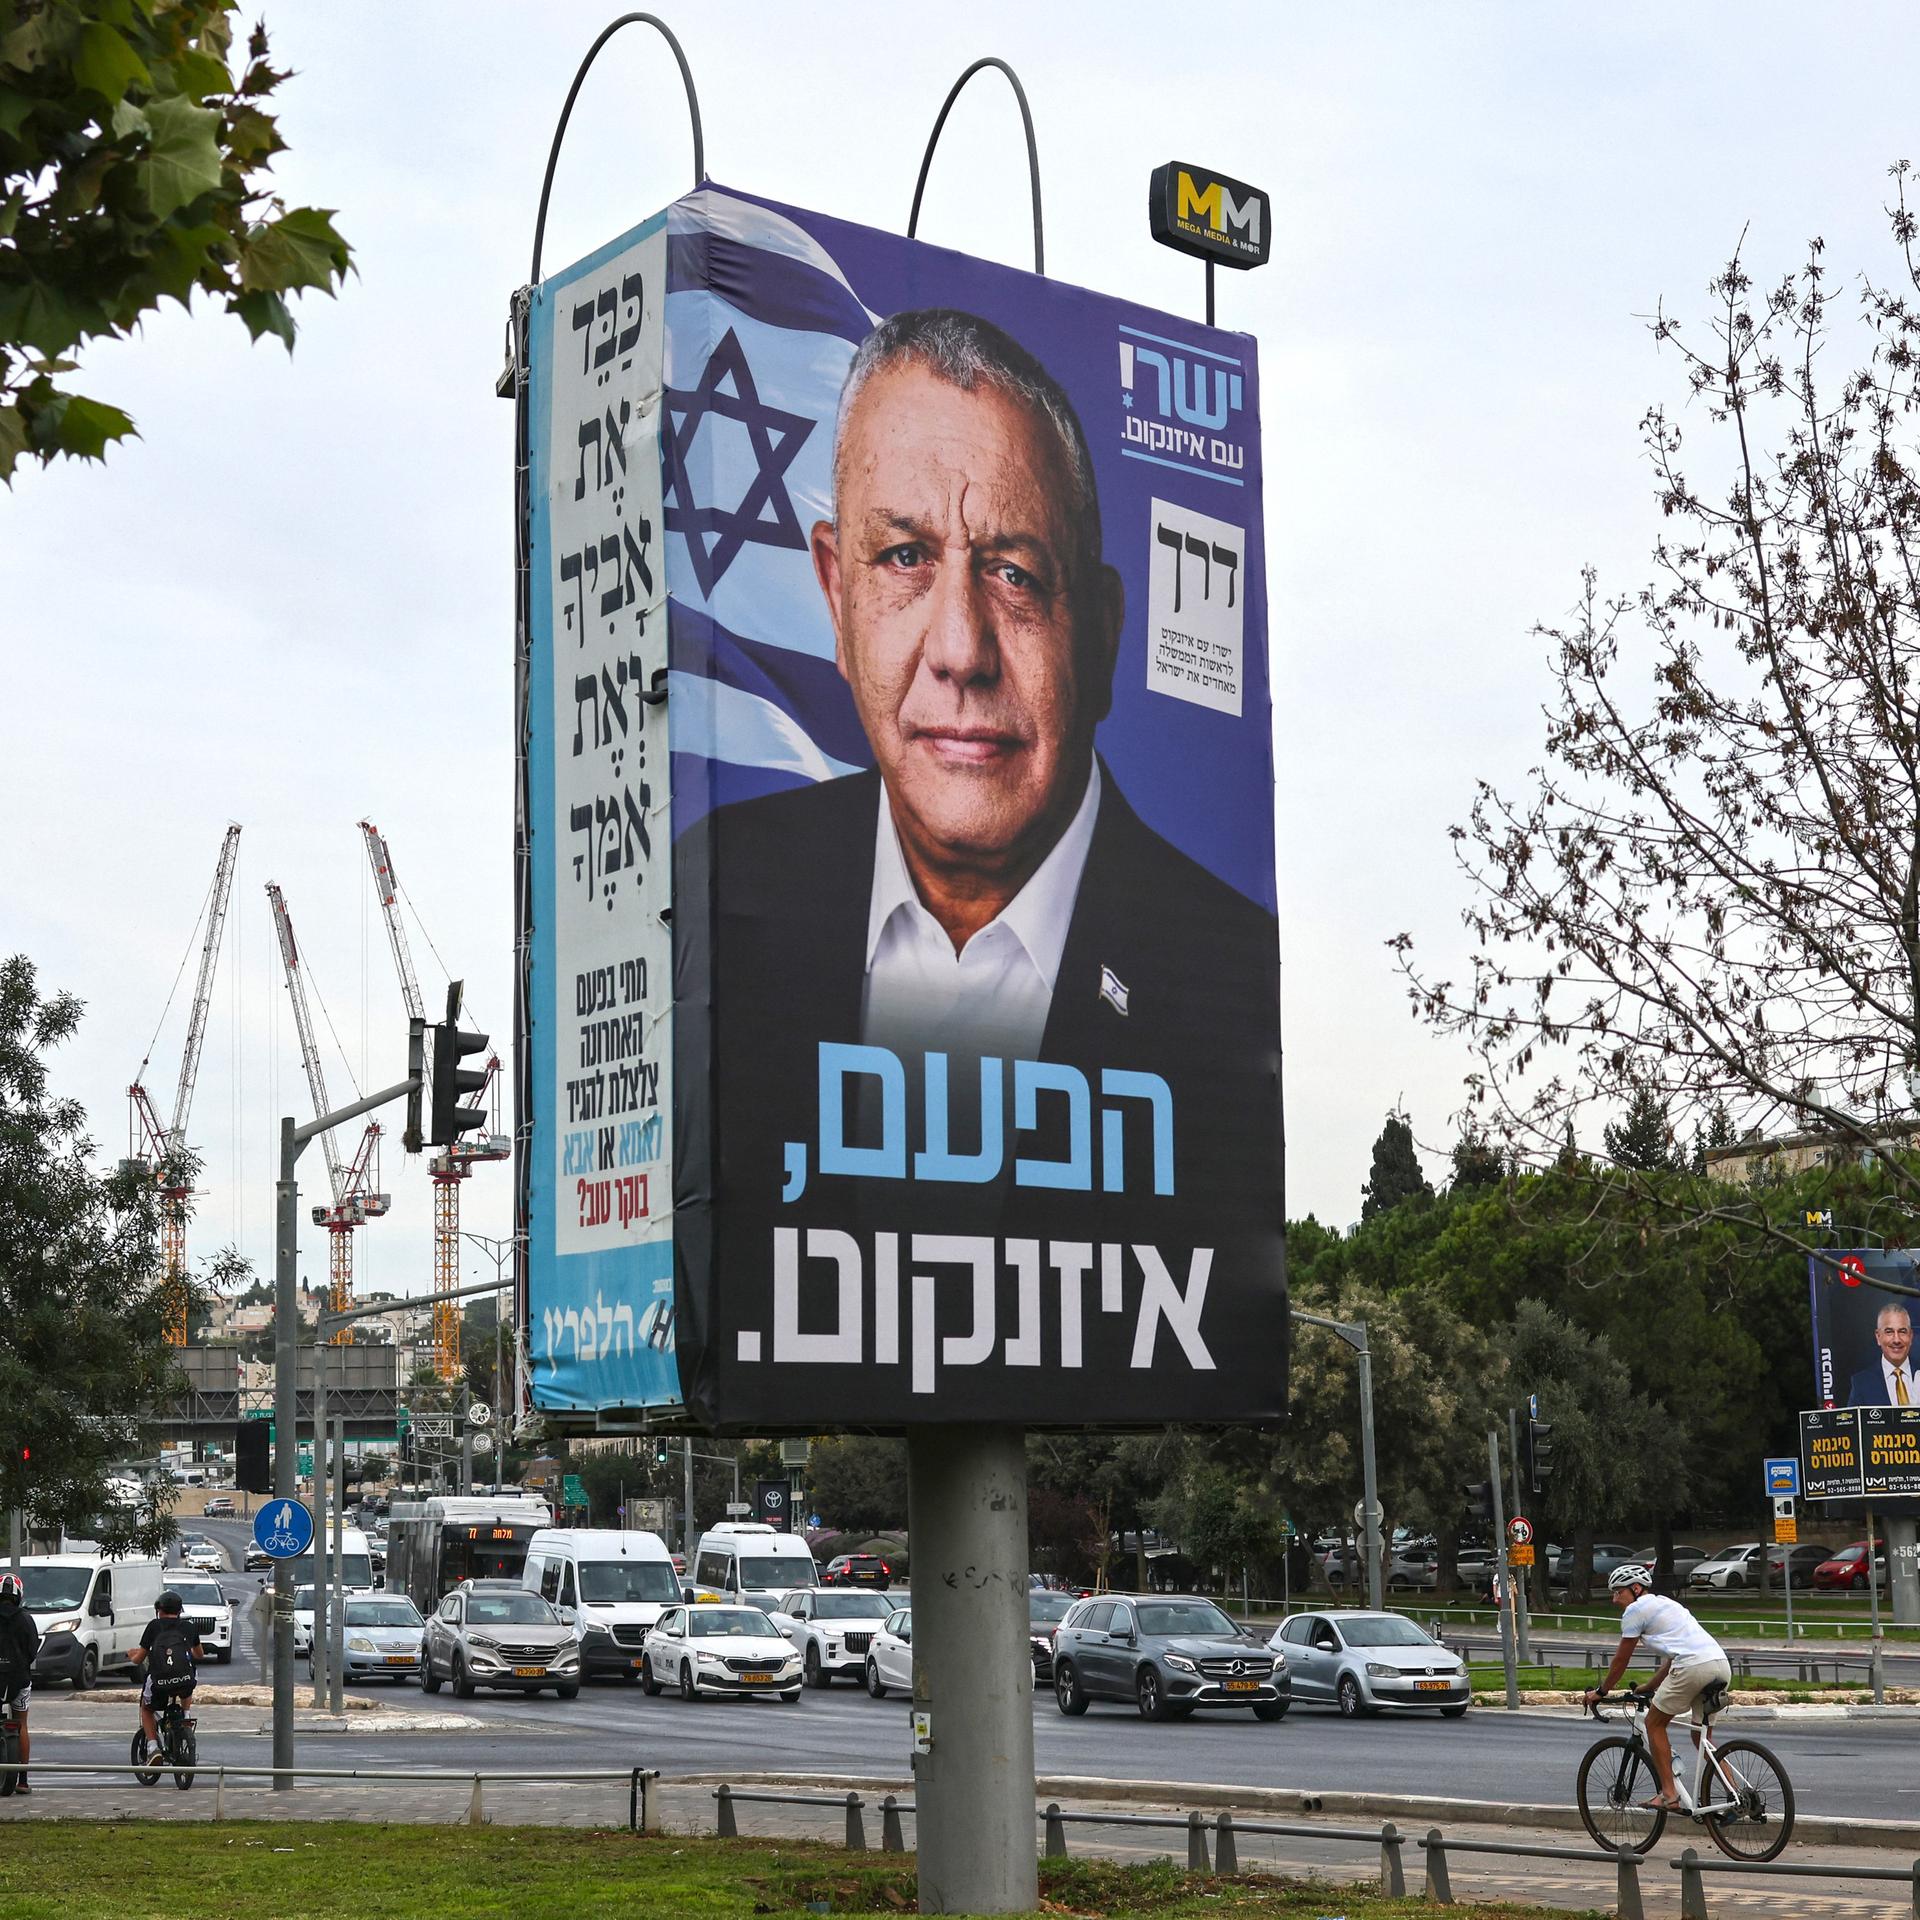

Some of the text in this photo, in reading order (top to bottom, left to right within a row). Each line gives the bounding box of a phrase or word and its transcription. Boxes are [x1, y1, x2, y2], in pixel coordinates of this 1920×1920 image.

[1177, 170, 1261, 244] MM
[1177, 219, 1260, 255] MEGA MEDIA & MOR
[1119, 341, 1243, 431] ישר!
[1121, 415, 1244, 469] עם איזנקוט.
[1157, 521, 1238, 614] דרך
[1159, 641, 1234, 677] לראשות הממשלה
[1161, 627, 1232, 658] ישר! עם איזנקוט
[1156, 655, 1236, 695] מאחדים את ישראל
[576, 956, 648, 1017] מתי בפעם
[580, 1011, 643, 1069] האחרונה
[566, 1059, 659, 1123] צלצלת להגיד
[782, 1041, 1175, 1203] הפעם,
[563, 1130, 594, 1176] אבא
[598, 1126, 615, 1171] או
[576, 1173, 649, 1229] בוקר טוב?
[737, 1226, 1217, 1394] איזנקוט.
[543, 1287, 634, 1380] הלפרין
[1811, 1452, 1854, 1469] מוטורס
[1812, 1436, 1851, 1453] סיגמא
[1870, 1450, 1920, 1465] מוטורס
[1873, 1433, 1916, 1449] סיגמא
[469, 1528, 478, 1539] 77
[492, 1529, 513, 1539] מלחה
[167, 1656, 173, 1666] 4
